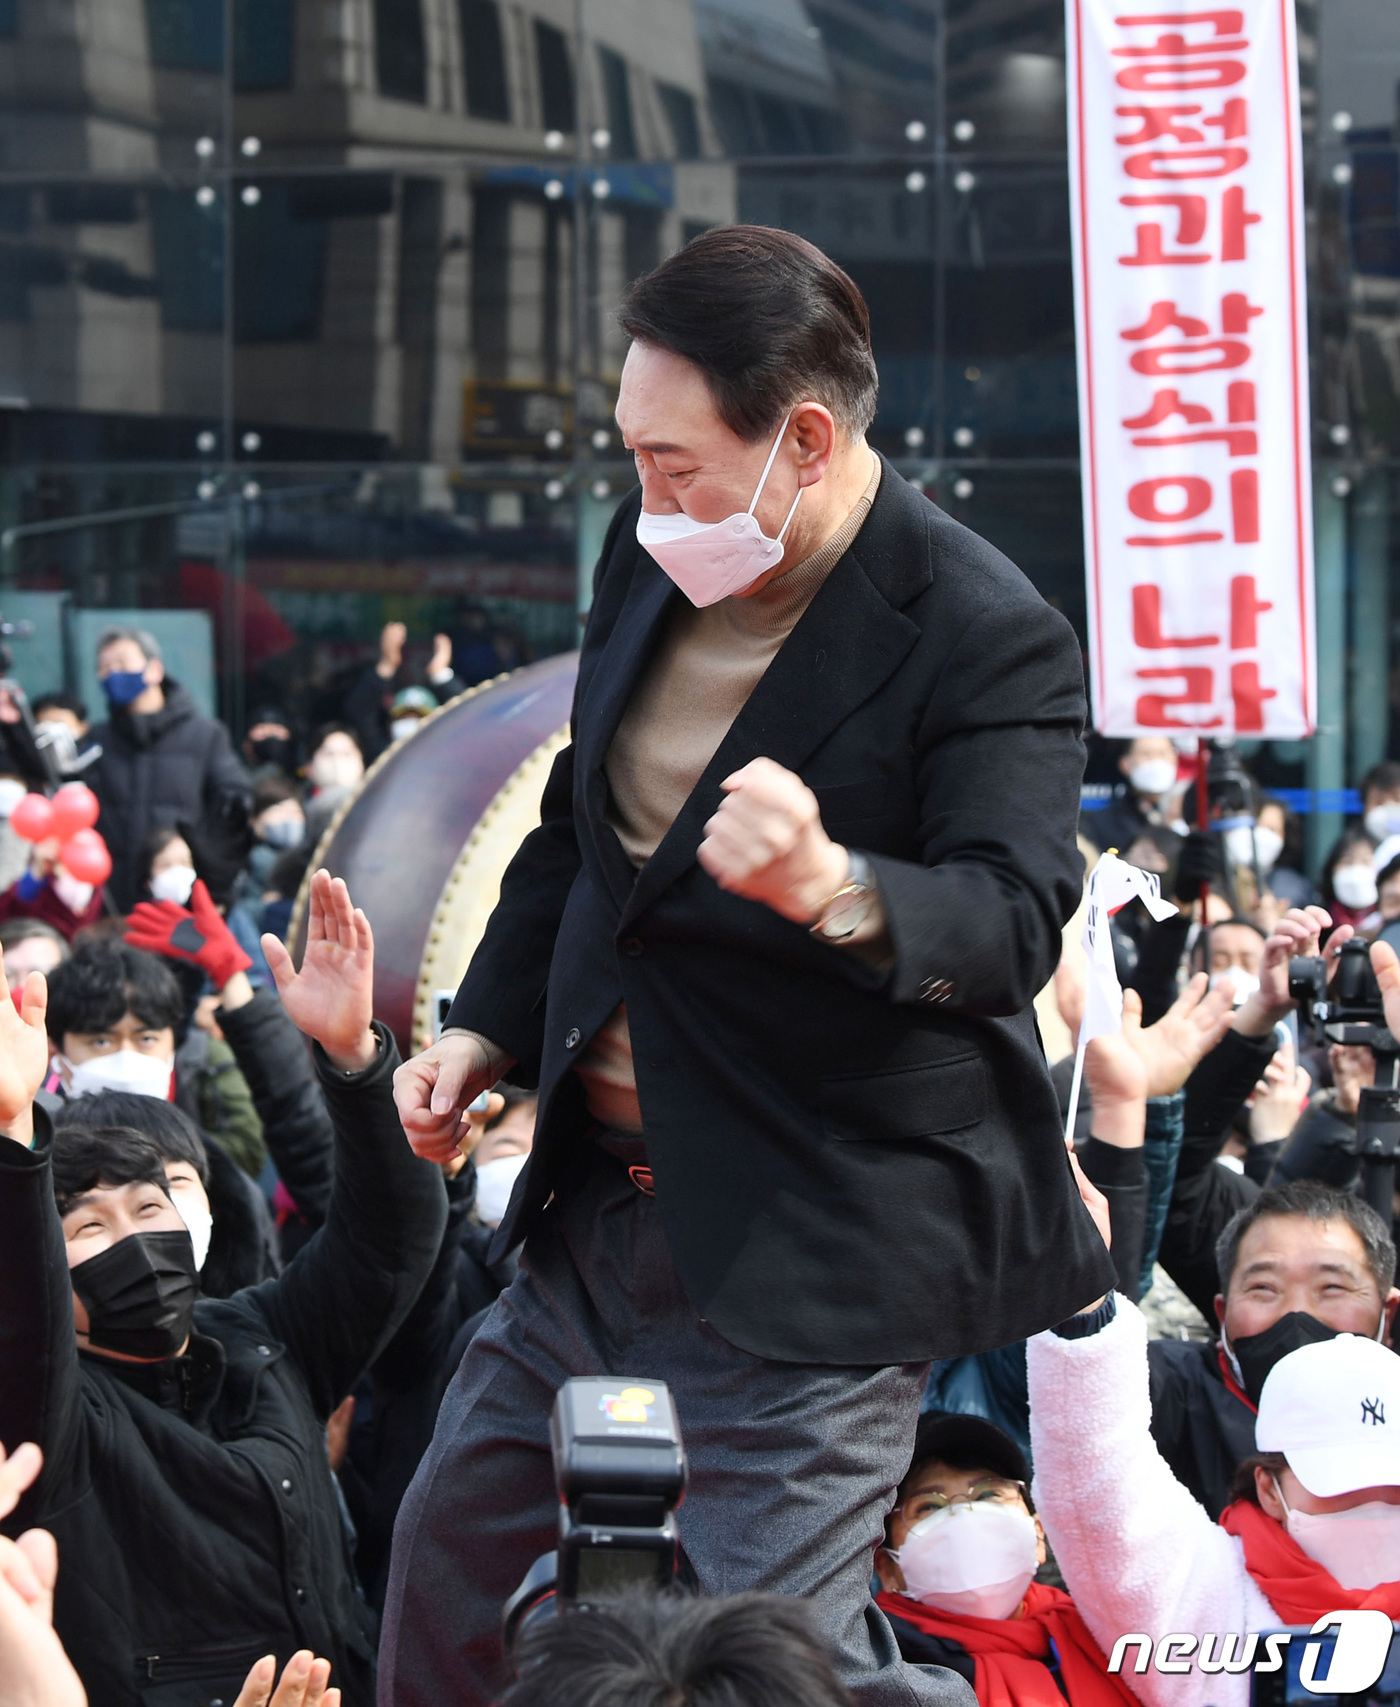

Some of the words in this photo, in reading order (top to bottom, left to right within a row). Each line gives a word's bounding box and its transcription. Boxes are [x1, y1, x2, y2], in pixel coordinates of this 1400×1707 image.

[1111, 10, 1261, 266] 공정과
[1119, 292, 1264, 547] 상식의
[1131, 574, 1277, 732] 나라
[1360, 1396, 1386, 1426] NY
